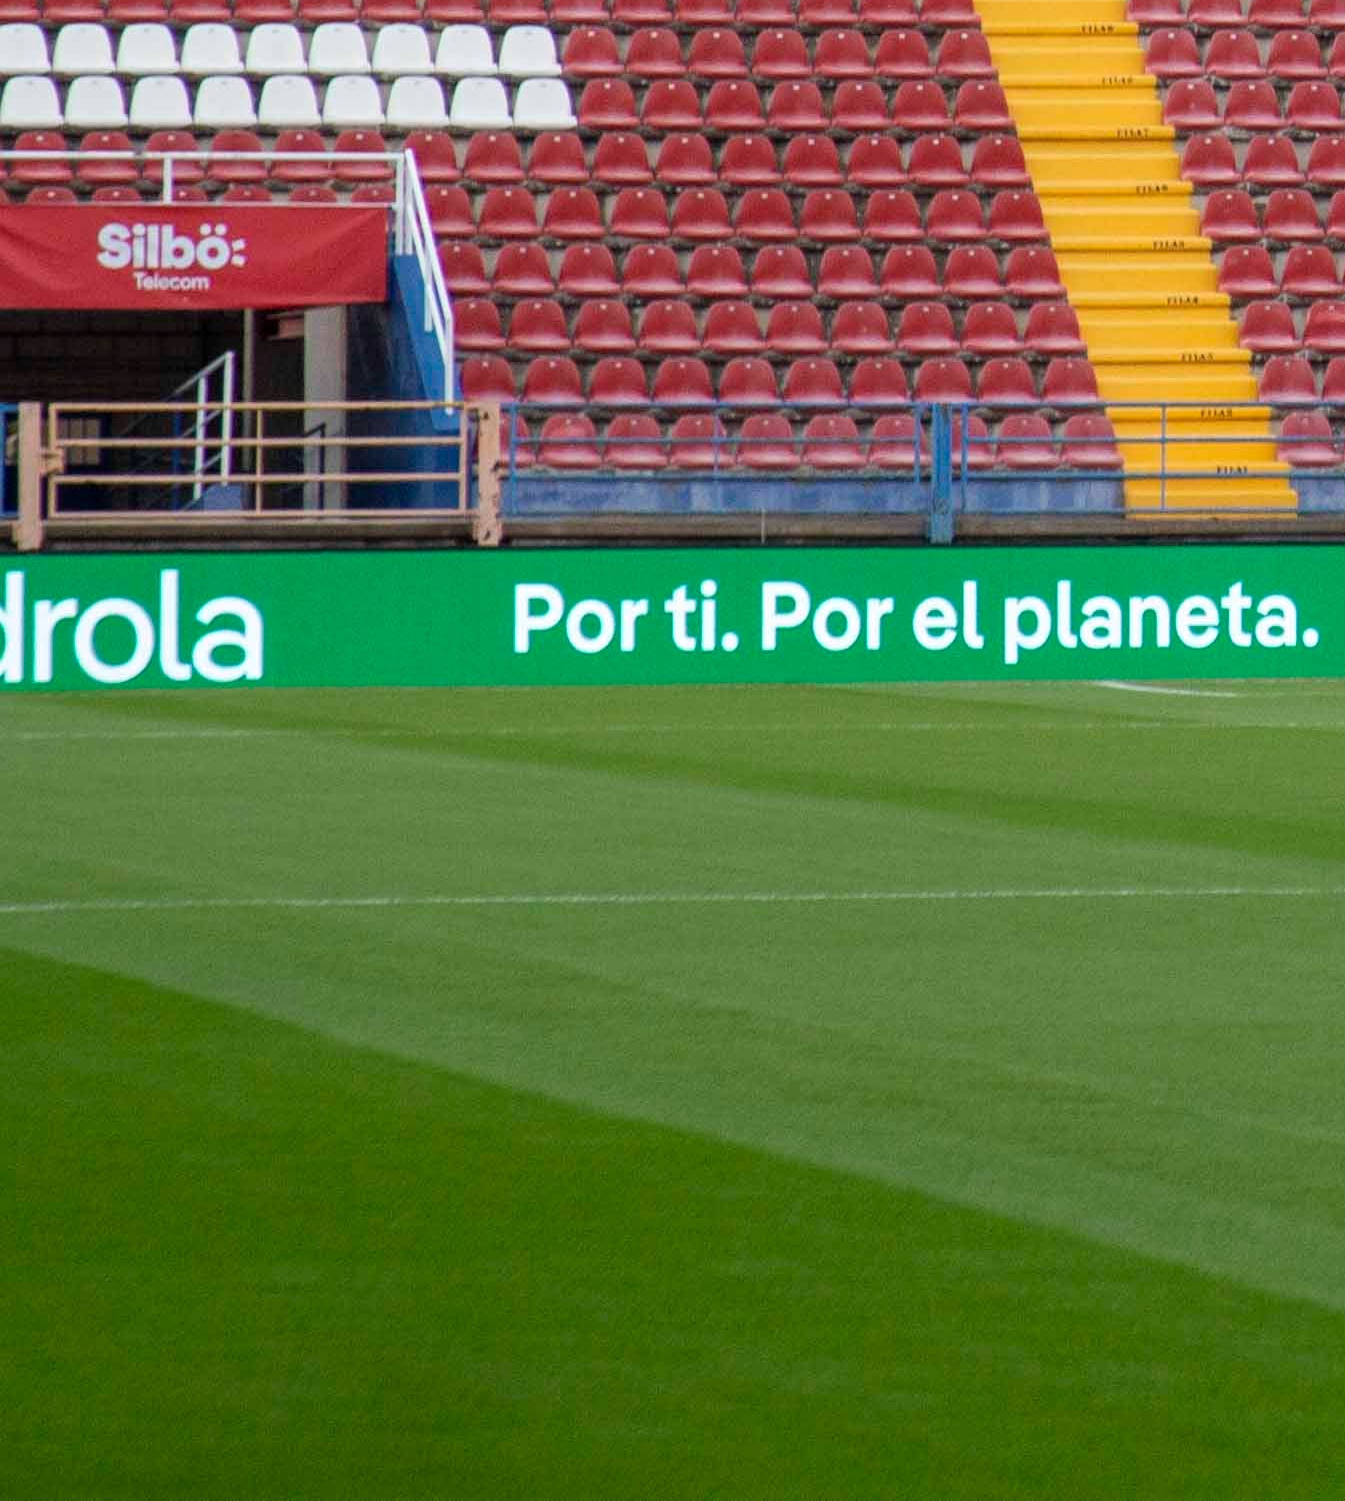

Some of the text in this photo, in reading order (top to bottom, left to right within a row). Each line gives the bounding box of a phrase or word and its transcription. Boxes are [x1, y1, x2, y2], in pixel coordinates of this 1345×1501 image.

[133, 271, 210, 291] Telecom
[515, 579, 1319, 664] Por ti. Por el planeta.
